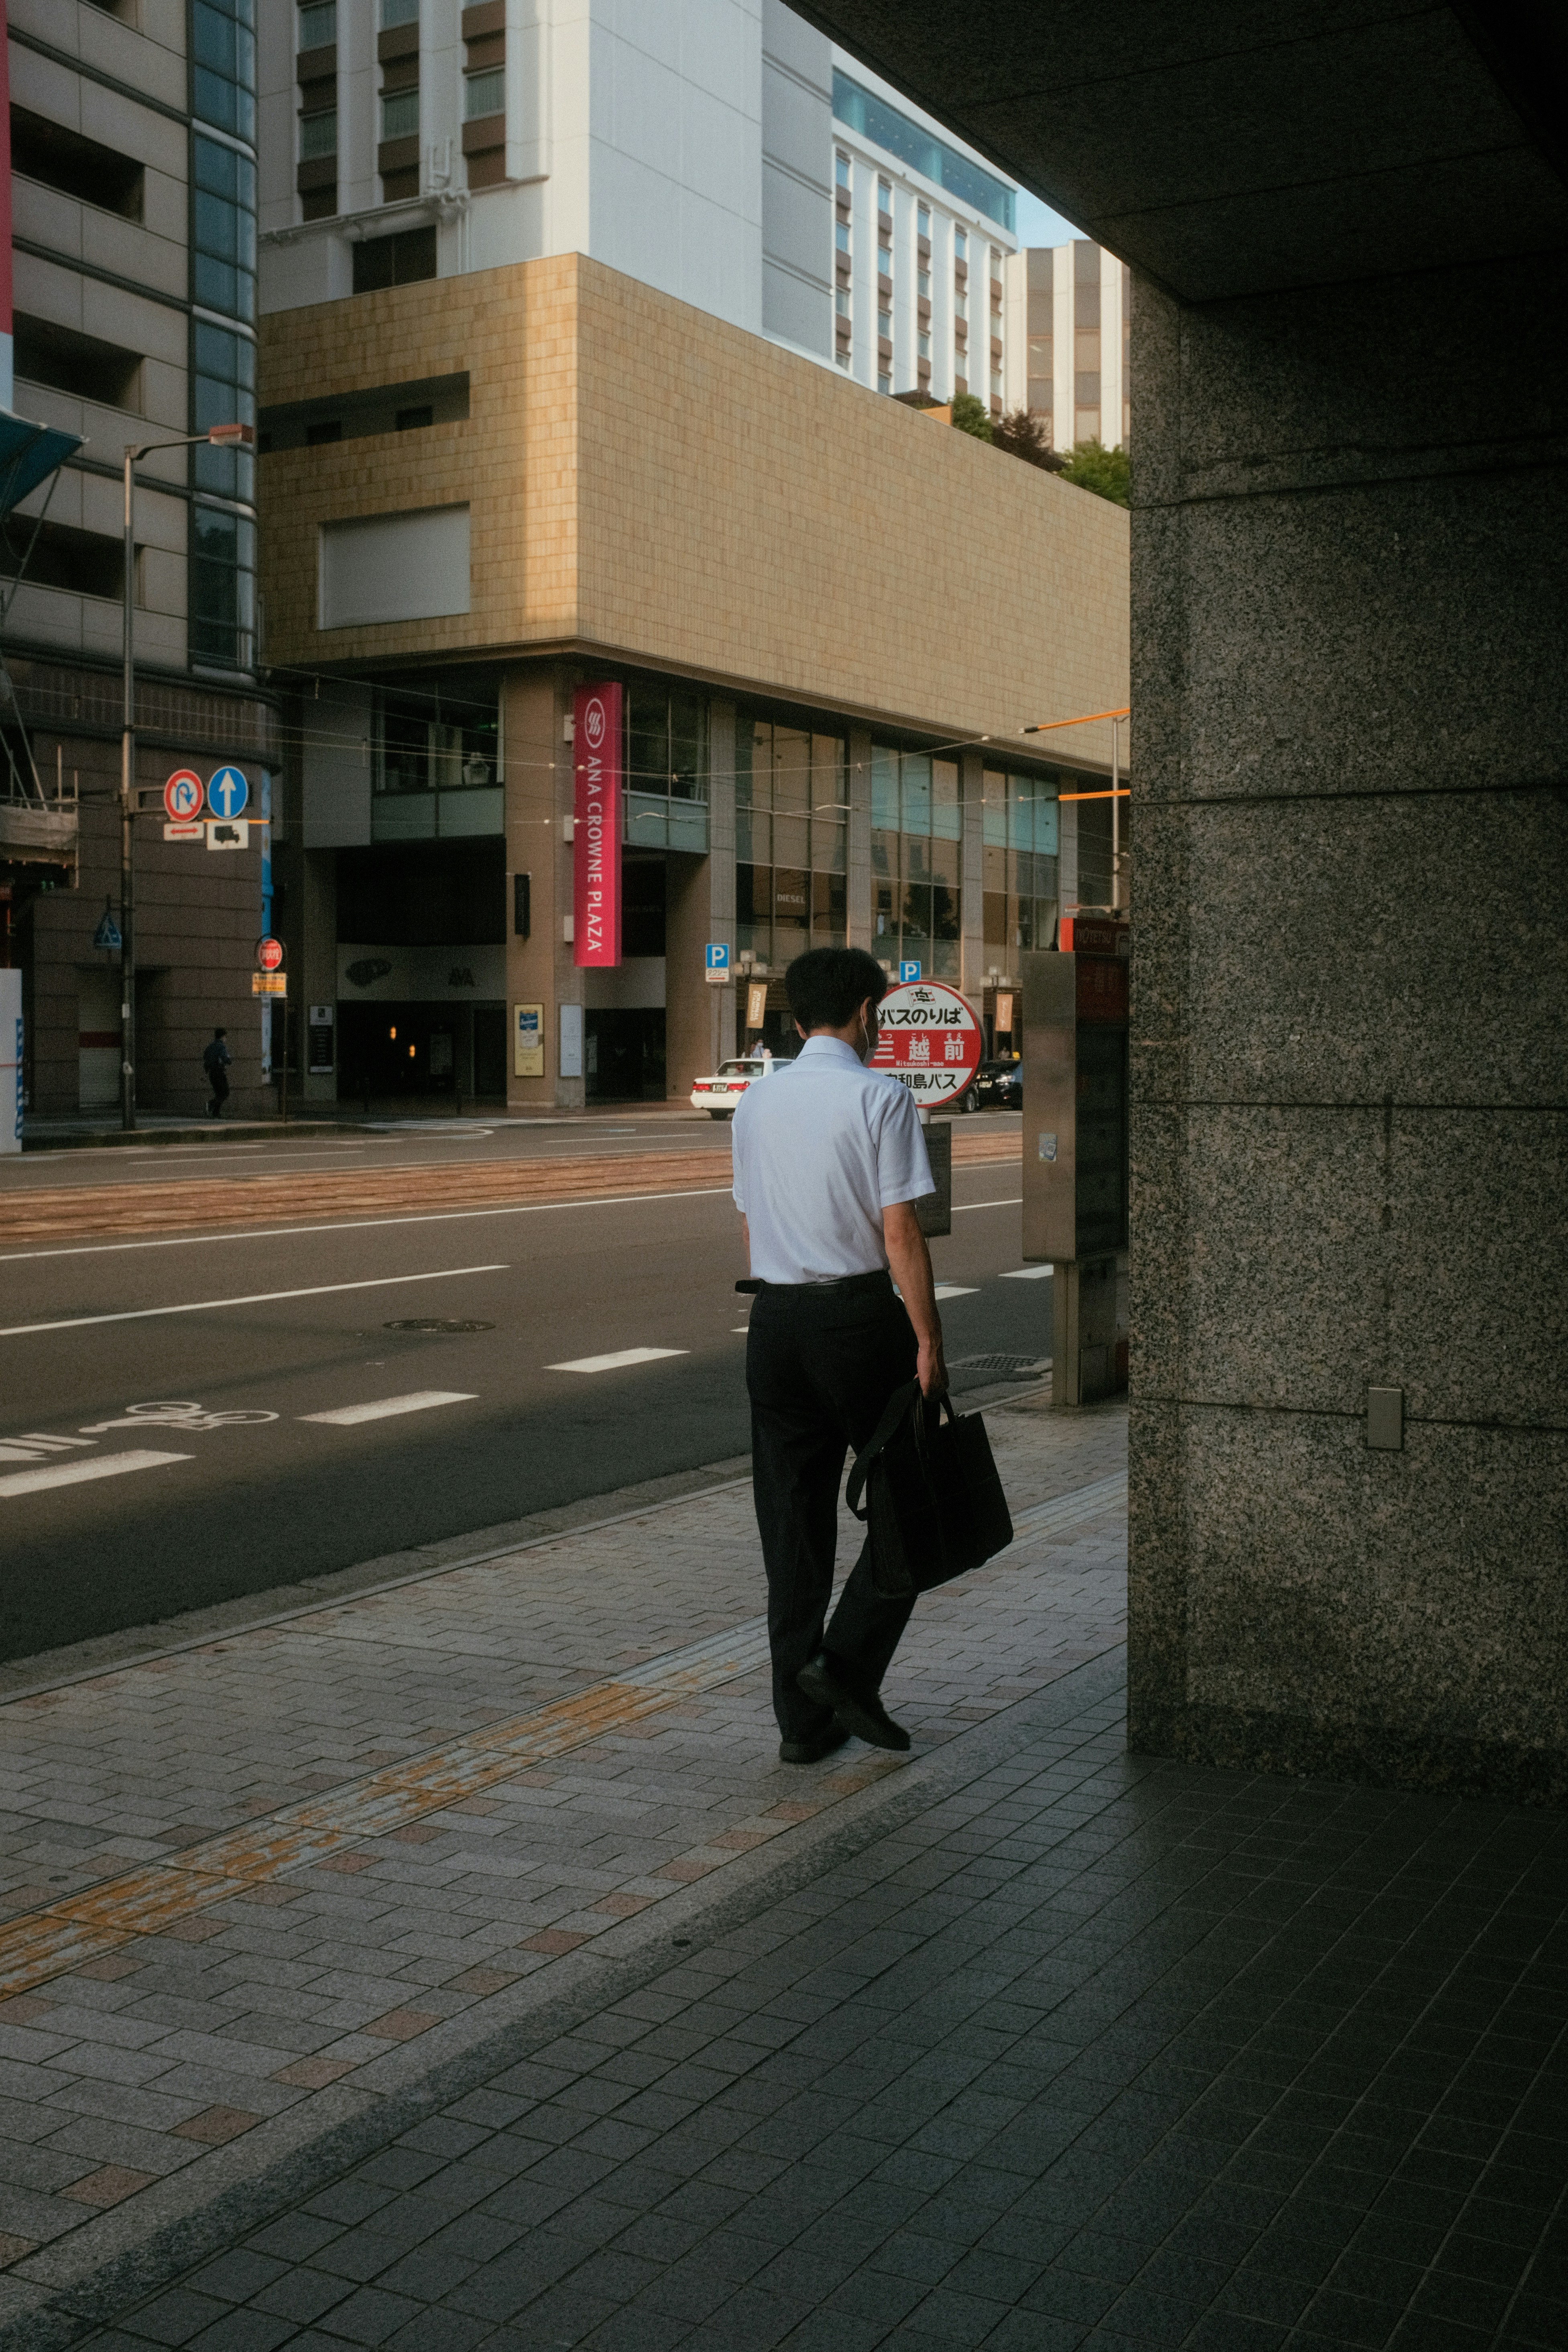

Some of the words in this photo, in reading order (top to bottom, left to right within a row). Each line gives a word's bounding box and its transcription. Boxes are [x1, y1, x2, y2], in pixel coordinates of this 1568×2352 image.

[587, 756, 602, 795] ANA
[587, 802, 602, 883] CROWNE
[777, 894, 805, 904] DIESEL
[587, 890, 602, 951] PLAZA
[712, 946, 725, 966] P
[905, 963, 917, 981] P
[881, 1007, 964, 1025] バスのりば
[874, 1039, 965, 1061] 三越前
